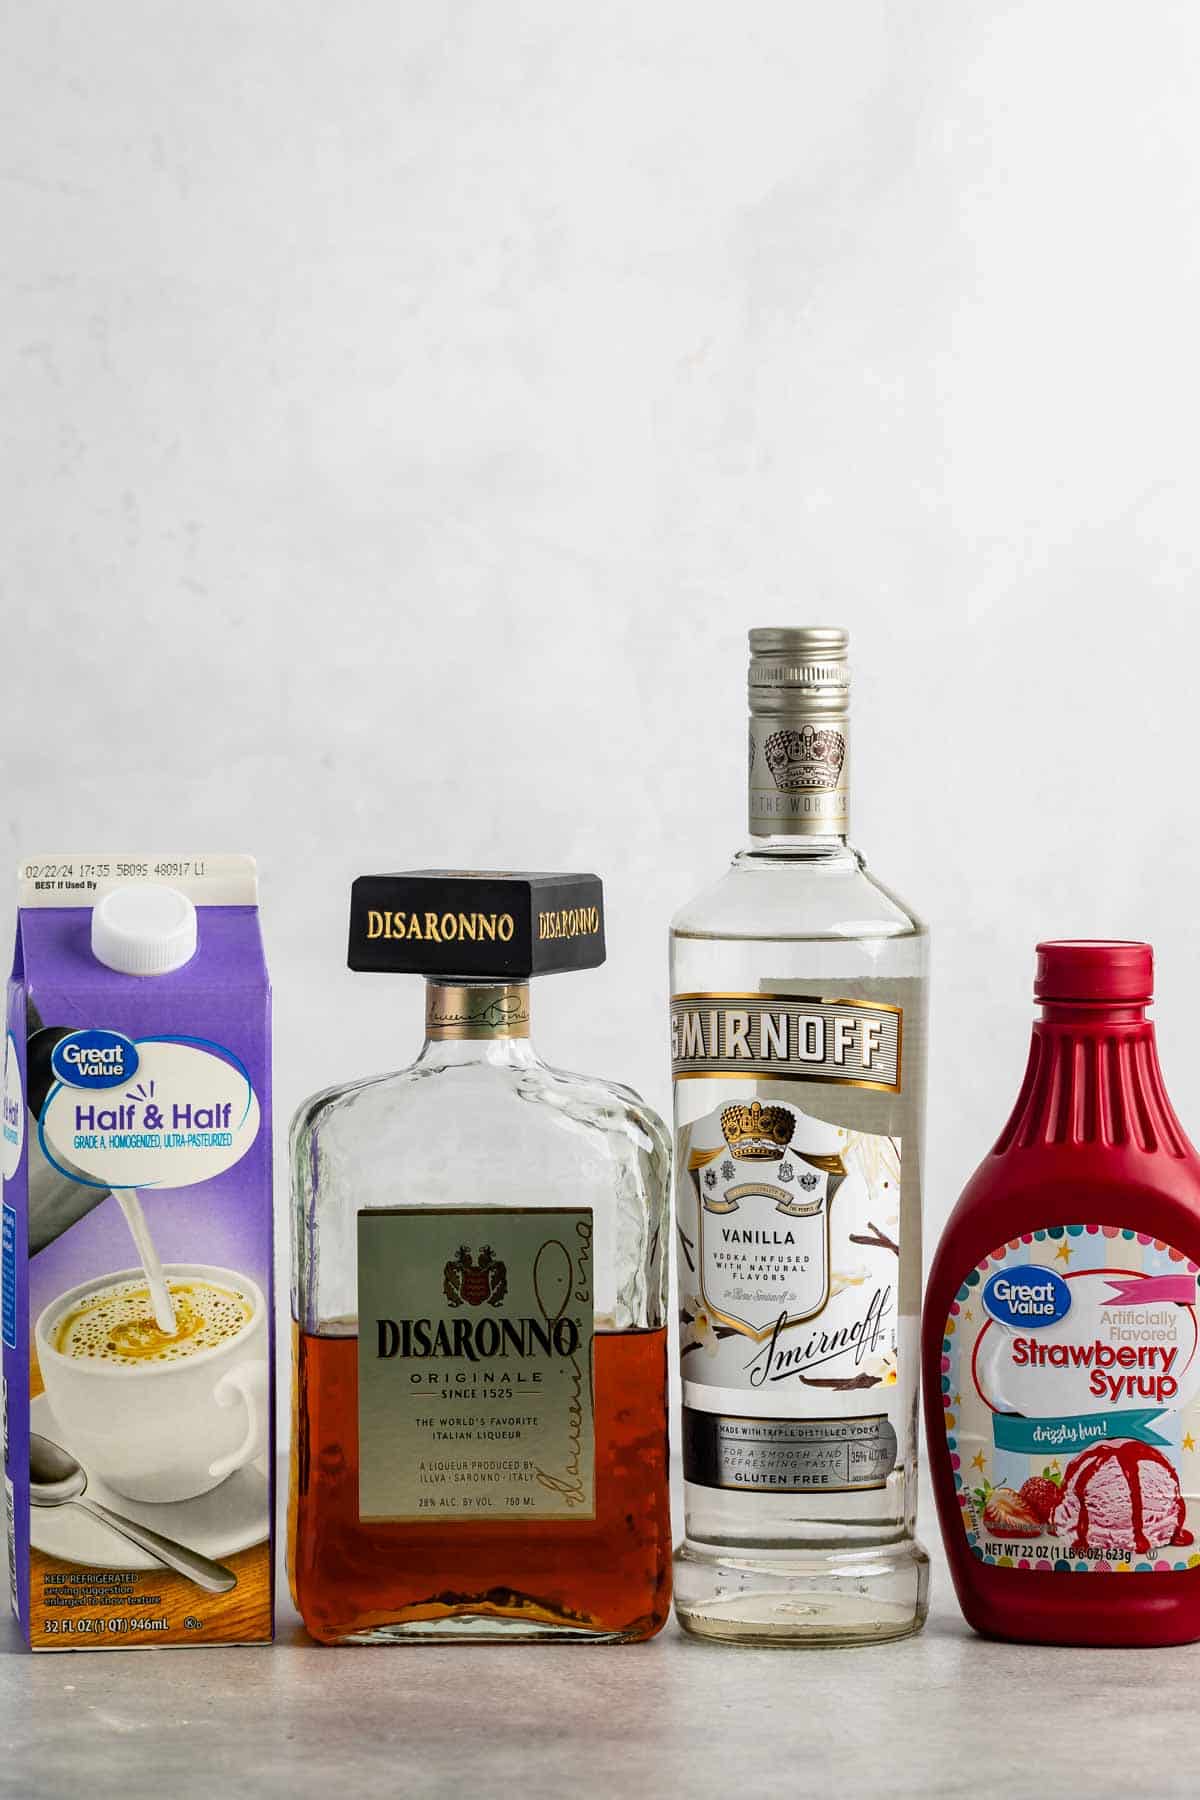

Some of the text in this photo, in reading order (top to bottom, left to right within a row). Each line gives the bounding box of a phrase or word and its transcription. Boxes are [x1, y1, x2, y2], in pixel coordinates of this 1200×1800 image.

[25, 864, 73, 879] 02/22/24
[79, 864, 110, 877] 17:35
[154, 862, 190, 876] 480917
[34, 880, 97, 890] BEST If Used By
[367, 911, 514, 942] DISARONNO
[538, 905, 599, 940] DISARONNO
[62, 1044, 124, 1064] Great
[77, 1062, 124, 1077] Value
[75, 1103, 232, 1131] Half & Half
[73, 1136, 99, 1149] GRADE
[164, 1133, 233, 1148] ULTRA-PASTEURIZED
[722, 1228, 796, 1245] VANILLA
[713, 1252, 810, 1263] VODKA INFUSED
[750, 1264, 807, 1272] NATURAL
[732, 1272, 786, 1282] FLAVORS
[993, 1280, 1055, 1302] Great
[1008, 1299, 1055, 1316] Value
[1100, 1310, 1177, 1328] Artificially
[376, 1317, 579, 1362] DISARONNO
[743, 1284, 895, 1388] Smirnoff
[1109, 1327, 1177, 1342] Flavored
[1011, 1338, 1178, 1374] Strawberry
[410, 1372, 544, 1384] ORIGINALE
[1089, 1369, 1178, 1403] Syrup
[441, 1388, 513, 1399] SINCE 1525
[415, 1416, 539, 1427] THE WORLD'S FAVORITE
[432, 1430, 522, 1441] ITALIAN LIQUEUR
[720, 1424, 880, 1438] MADE WITH TRIPLE DISTILLED VODKA
[1033, 1421, 1108, 1444] drizzly fun!
[724, 1447, 743, 1457] FOR
[760, 1451, 811, 1460] SMOOTH
[817, 1451, 842, 1459] AND
[420, 1460, 534, 1471] A LIQUEUR PRODUCED BY
[723, 1457, 842, 1469] REFRESHING TASTE
[420, 1472, 535, 1483] ILLVA SARONNO ITALY
[735, 1472, 829, 1484] GLUTEN FREE
[462, 1497, 473, 1506] BY
[523, 1496, 536, 1506] ML
[985, 1542, 1132, 1564] NET WT 22 OZ (1 LB 6 OZ) 623g
[44, 1574, 140, 1584] KEEP REFRIGERATED
[81, 1585, 135, 1597] suggestion
[45, 1597, 87, 1608] enlarged
[127, 1596, 161, 1605] texture
[45, 1618, 169, 1632] 32 FL OZ (1 QT) 946mL
